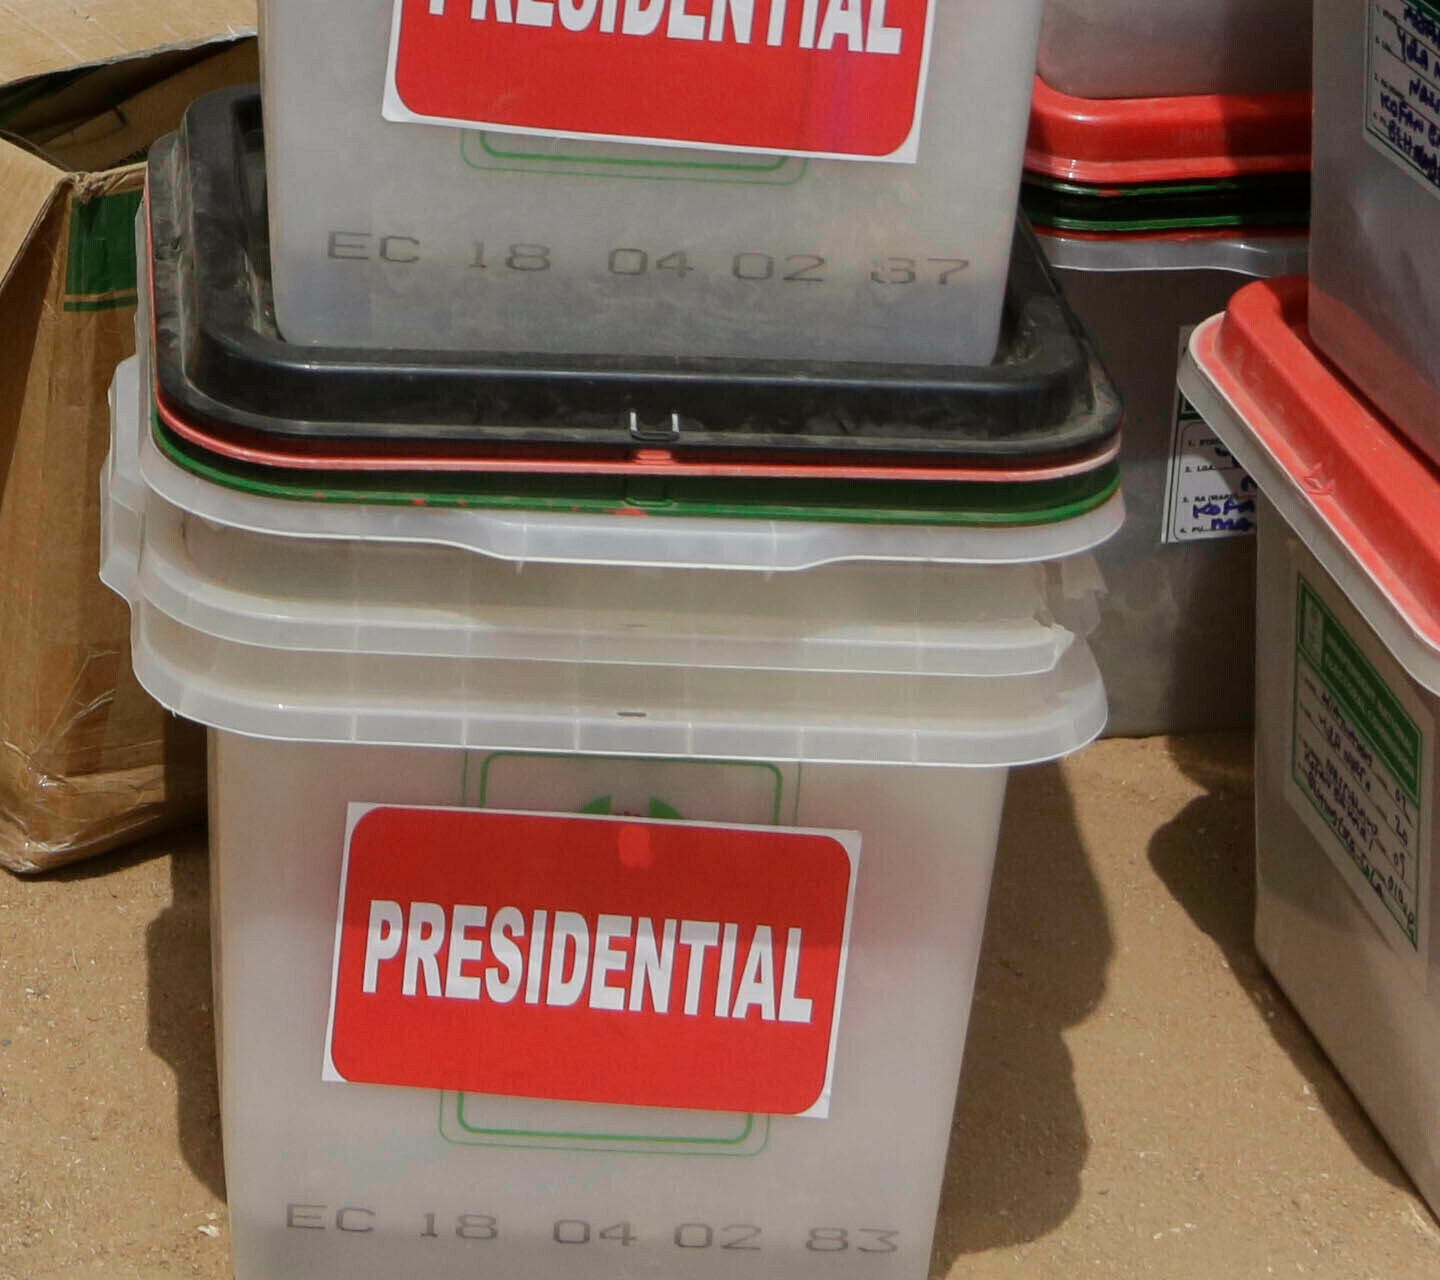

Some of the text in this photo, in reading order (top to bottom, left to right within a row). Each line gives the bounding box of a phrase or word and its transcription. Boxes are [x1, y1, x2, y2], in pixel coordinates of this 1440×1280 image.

[326, 231, 420, 266] EC
[468, 240, 553, 274] 18
[607, 248, 695, 281] 04
[730, 253, 826, 284] 02
[362, 899, 814, 1025] PRESIDENTIAL
[286, 1203, 900, 1254] EC 18 04 02 83
